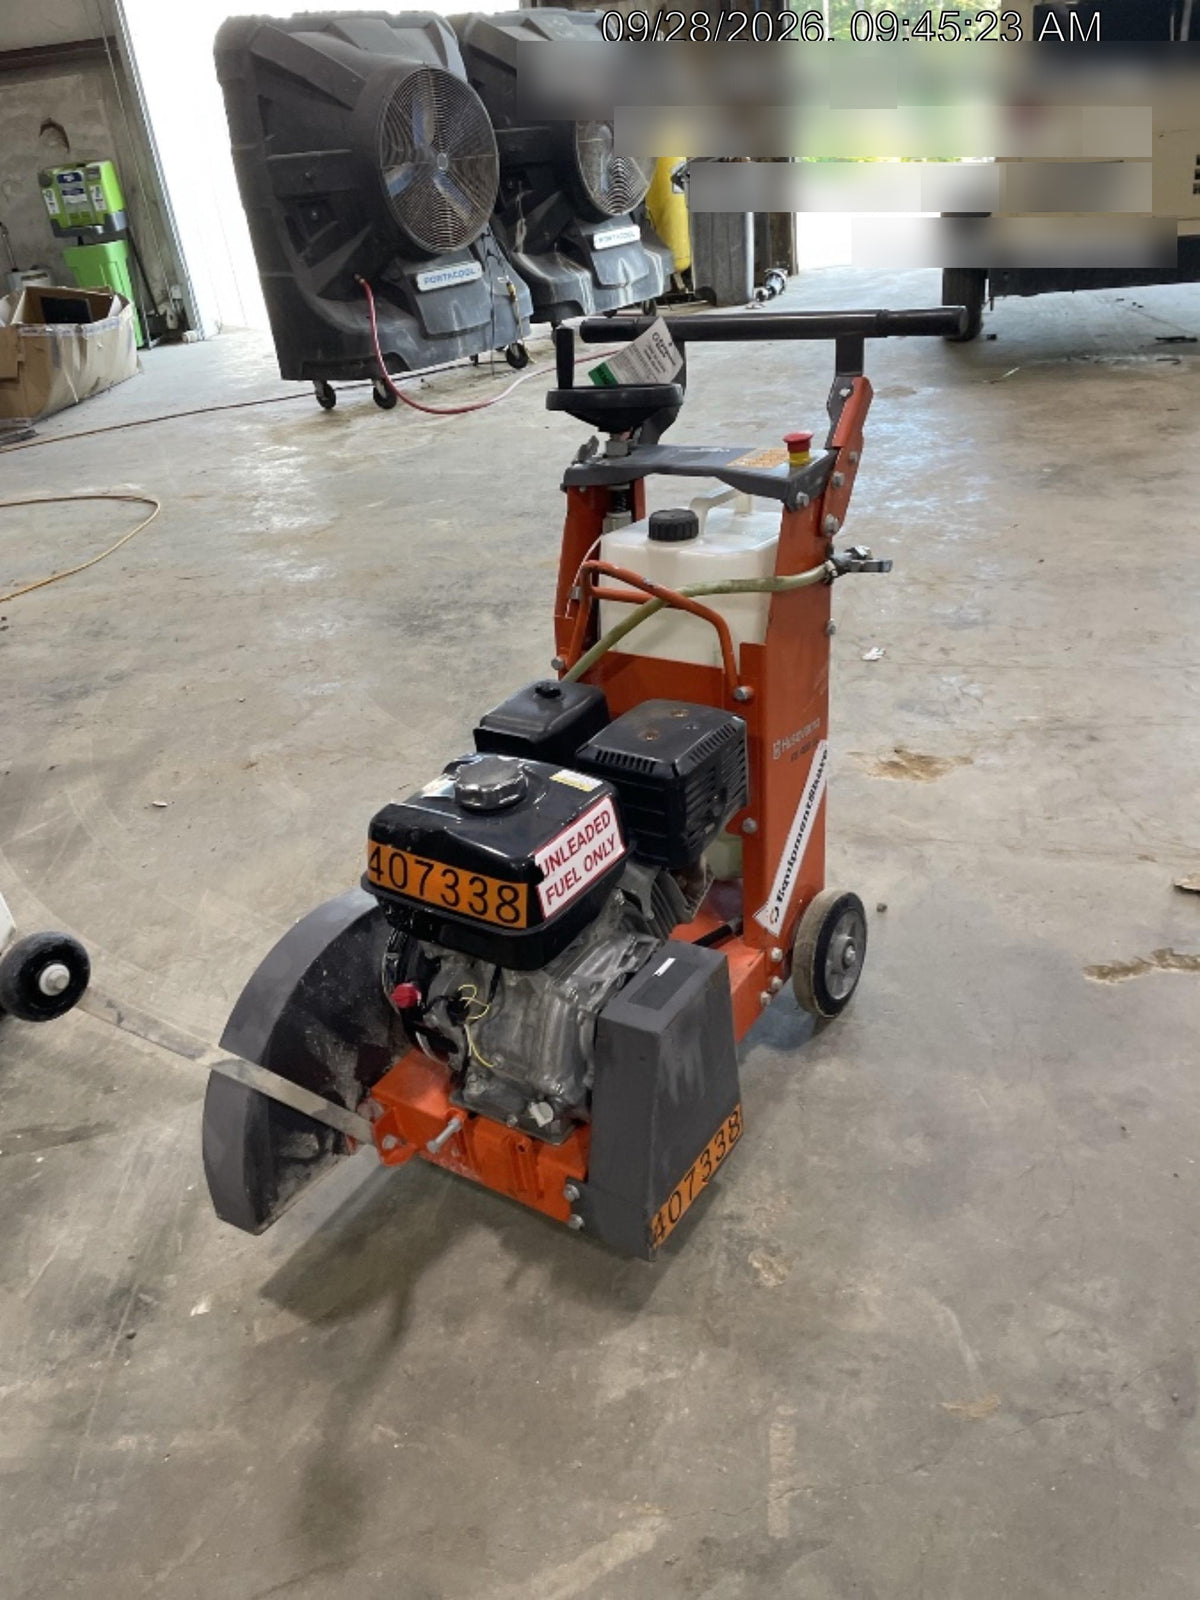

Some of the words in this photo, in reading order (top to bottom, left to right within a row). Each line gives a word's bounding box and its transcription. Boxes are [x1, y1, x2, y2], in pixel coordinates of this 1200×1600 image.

[368, 845, 520, 925] 407338
[545, 867, 582, 906] FUEL
[583, 833, 615, 873] ONLY
[652, 1110, 741, 1244] 407338
